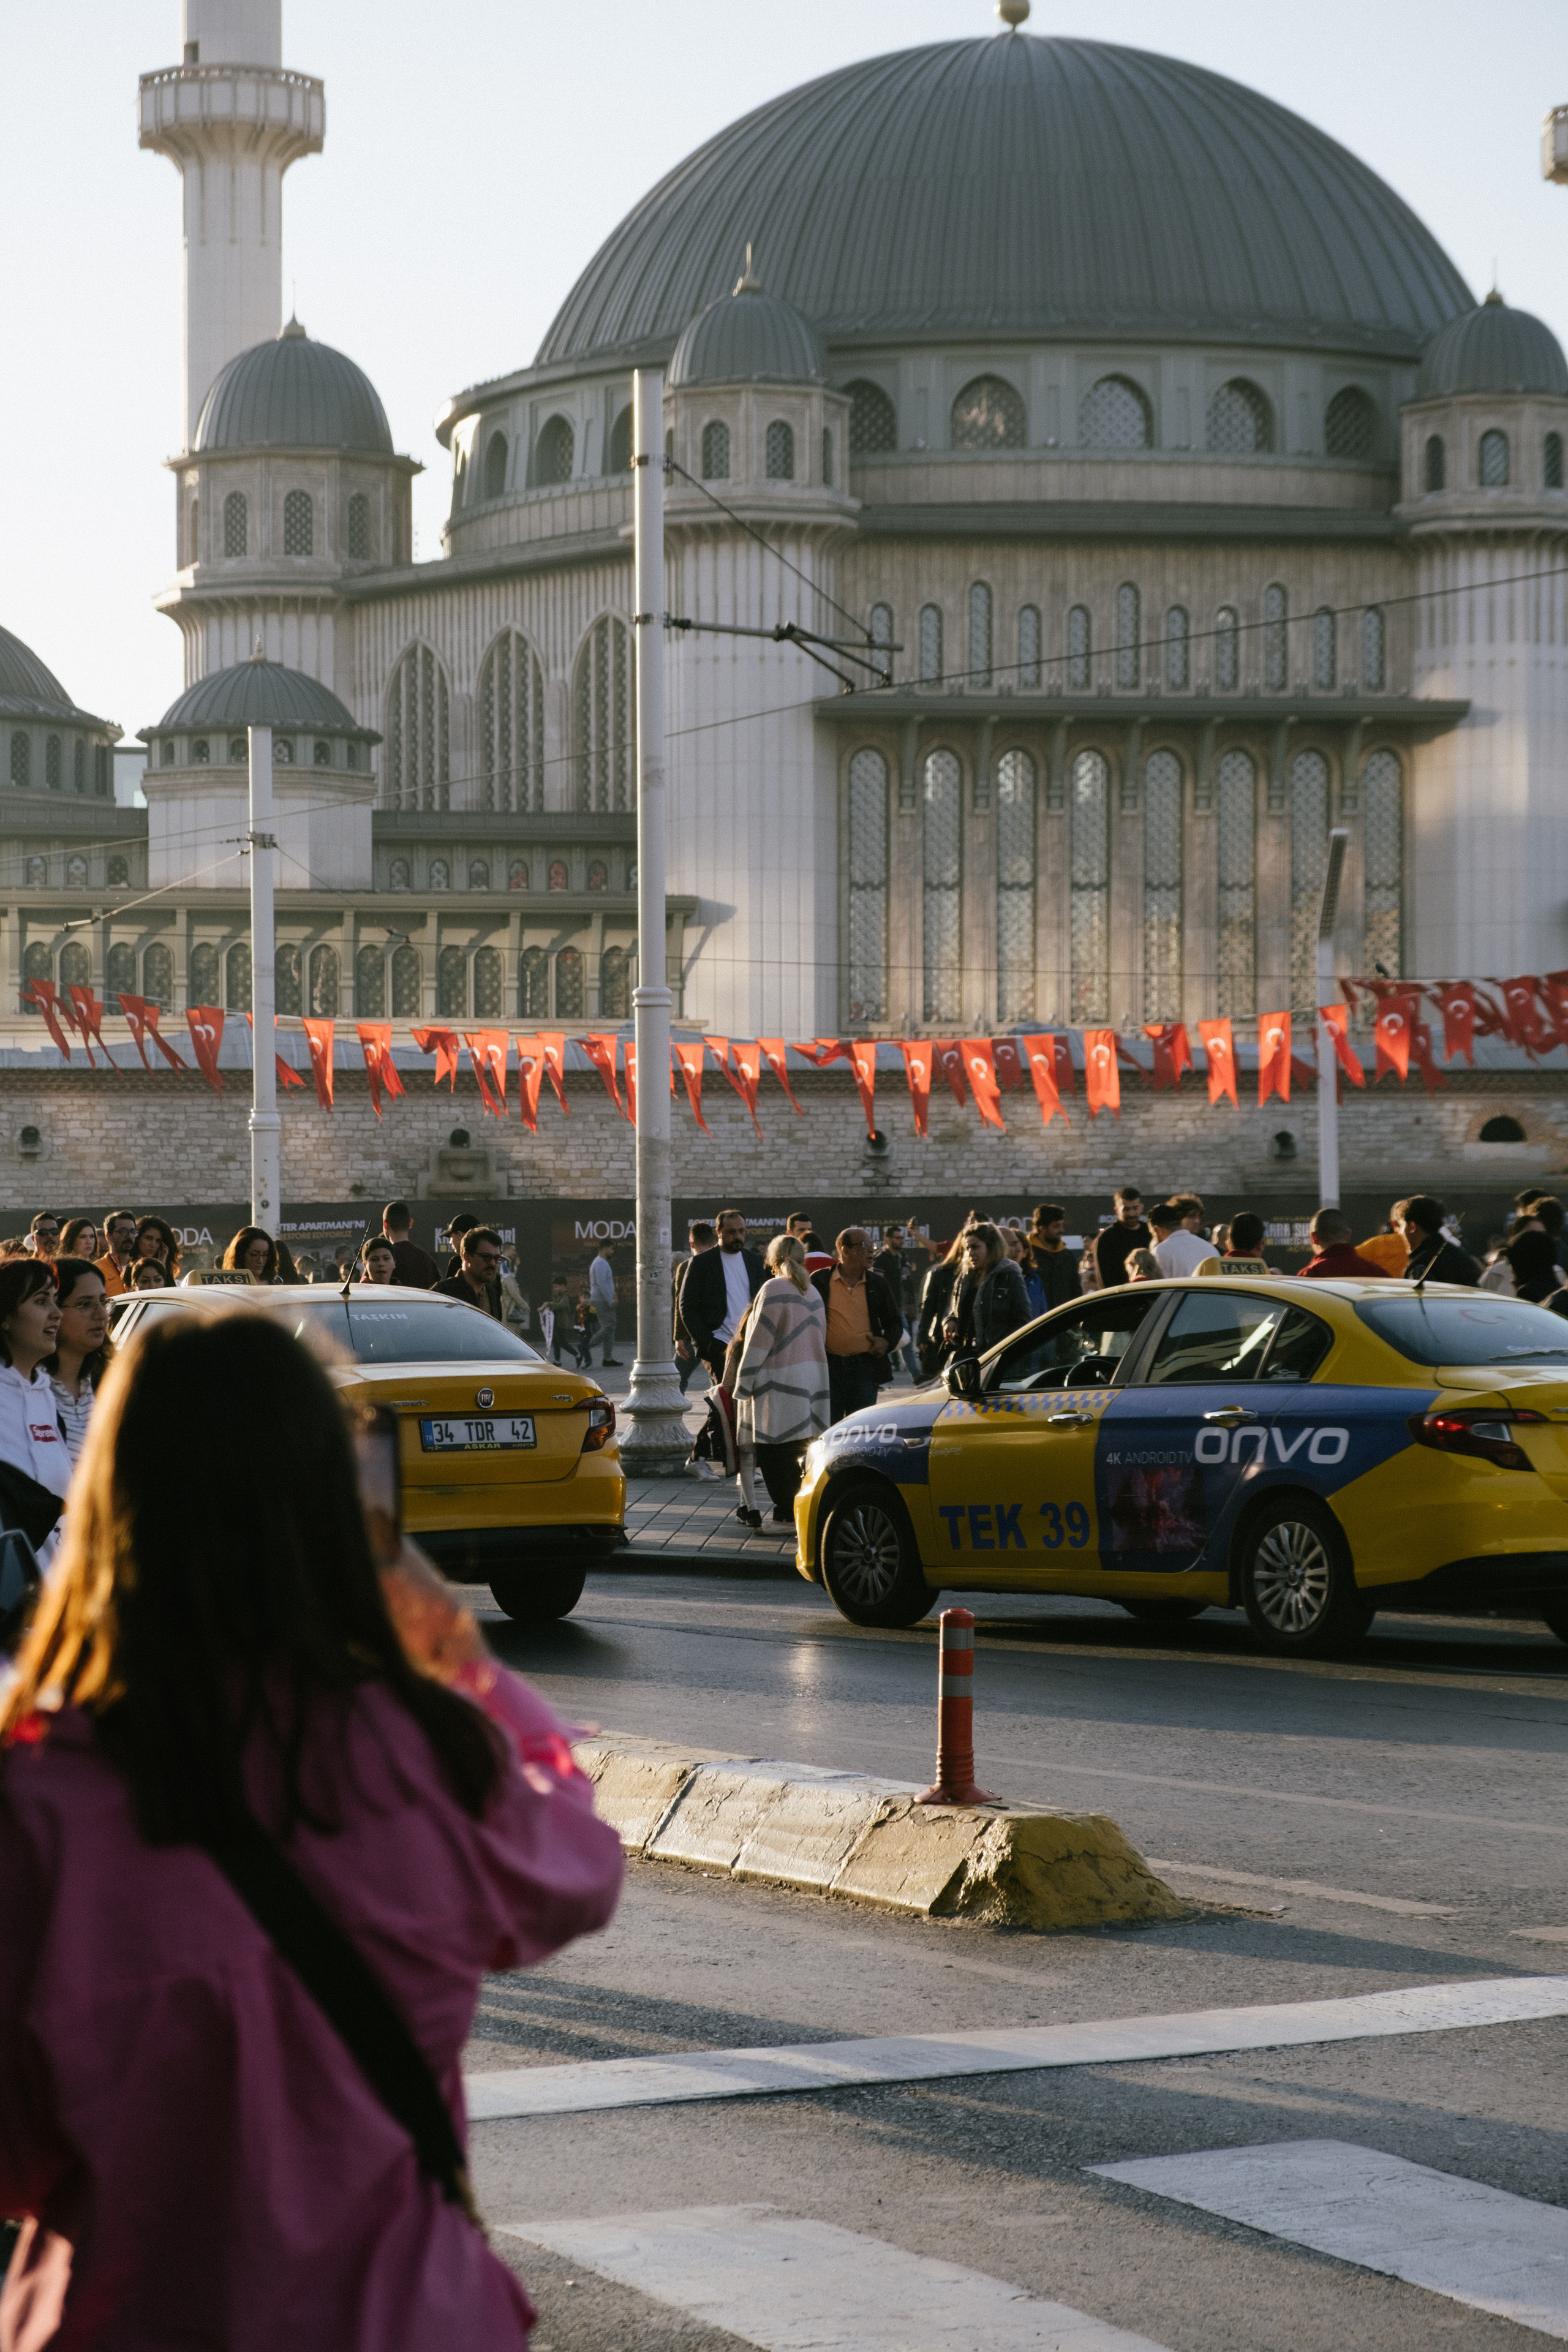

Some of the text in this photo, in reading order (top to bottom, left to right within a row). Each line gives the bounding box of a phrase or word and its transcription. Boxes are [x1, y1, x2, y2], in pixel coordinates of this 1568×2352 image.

[575, 1220, 636, 1239] MODA
[987, 1216, 1033, 1234] MOD
[174, 1227, 214, 1246] ODA
[350, 1313, 408, 1322] TAŞKIN
[481, 1393, 492, 1402] FIAT
[433, 1423, 454, 1443] 34
[464, 1420, 496, 1442] TDR
[511, 1420, 531, 1441] 42
[1106, 1452, 1121, 1465] 4K
[938, 1501, 1091, 1550] TEK 39
